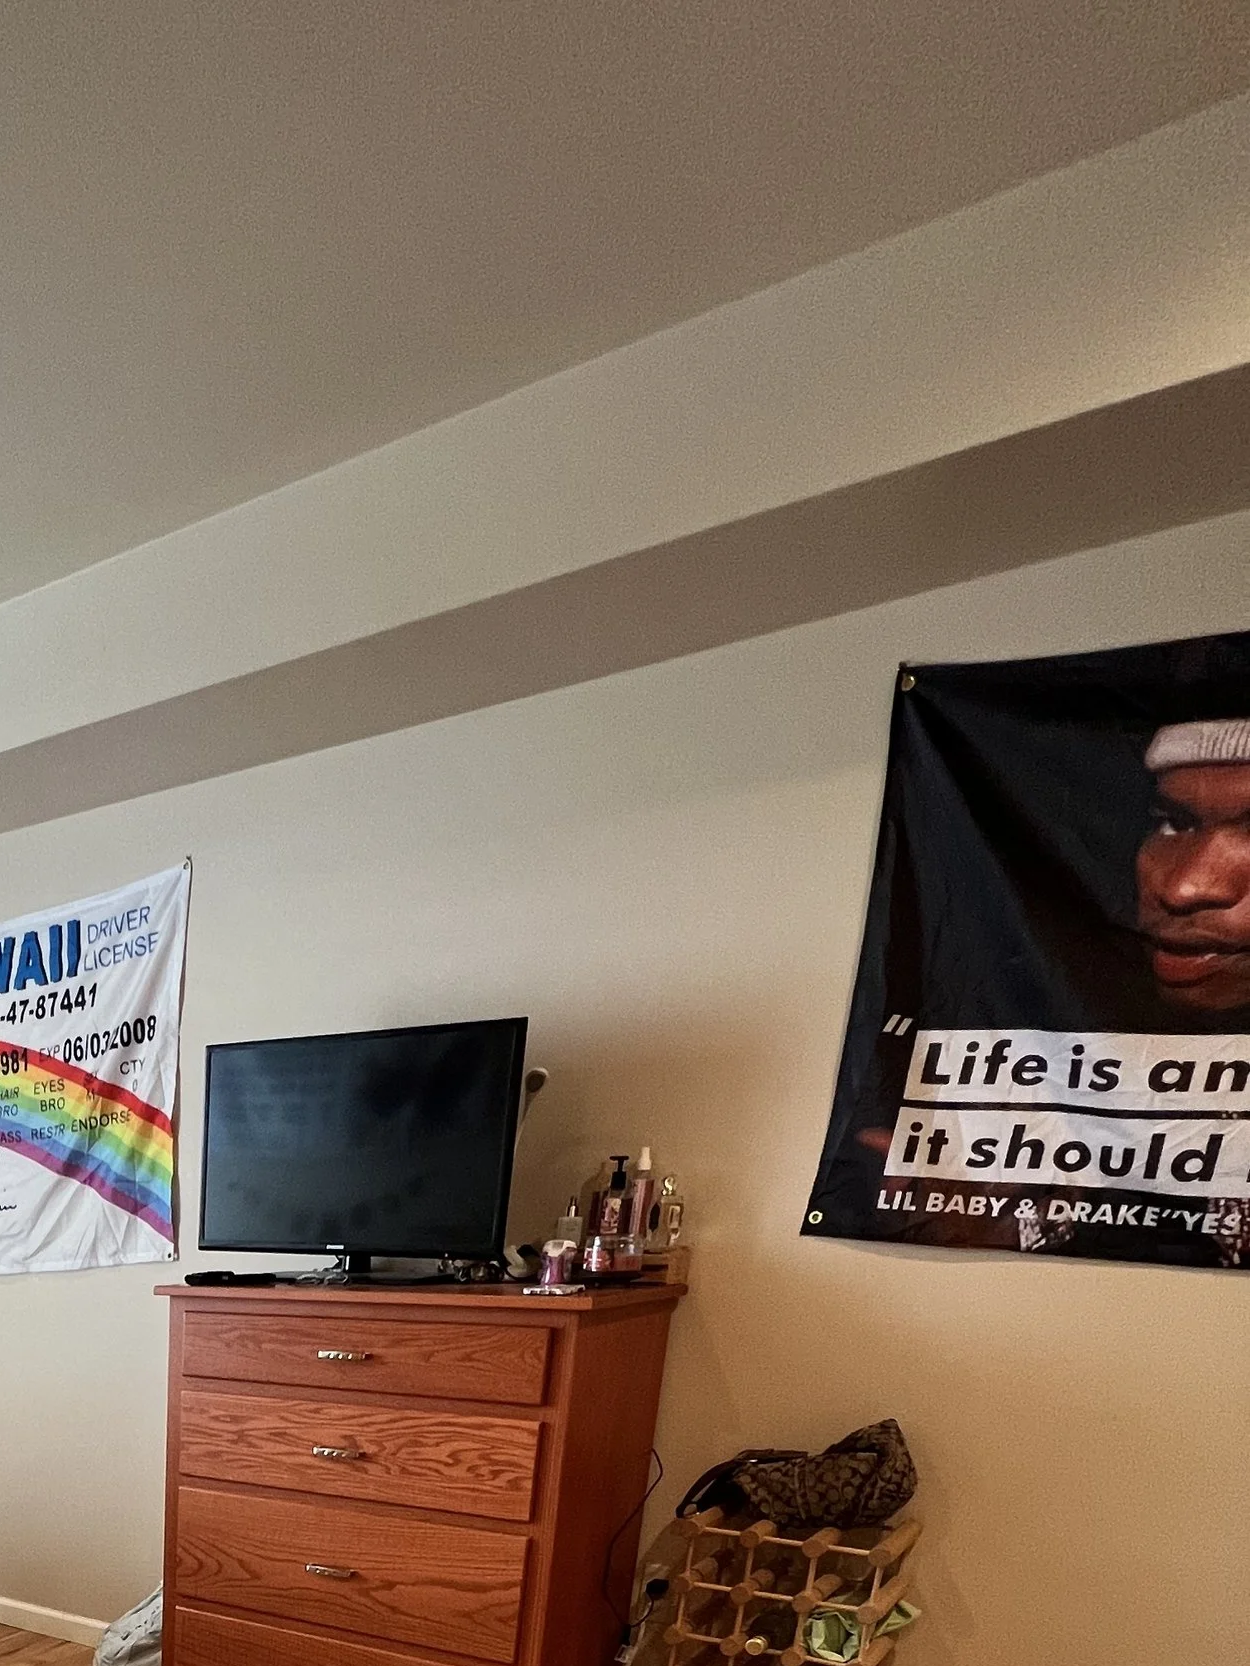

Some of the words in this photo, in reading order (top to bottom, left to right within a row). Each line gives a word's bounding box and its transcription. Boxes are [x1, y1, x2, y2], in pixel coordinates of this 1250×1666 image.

[87, 906, 151, 945] DRIVER
[83, 932, 159, 972] LICENSE
[39, 1044, 60, 1062] EXP
[1068, 1044, 1122, 1091] is
[33, 1079, 65, 1096] EYES
[119, 1057, 146, 1075] CTY
[40, 1097, 65, 1112] BRO
[31, 1123, 66, 1140] RESTR
[902, 1122, 949, 1165] it
[965, 1124, 1224, 1182] should
[876, 1189, 917, 1212] LIL
[925, 1192, 1007, 1217] BABY
[1014, 1198, 1038, 1220] &
